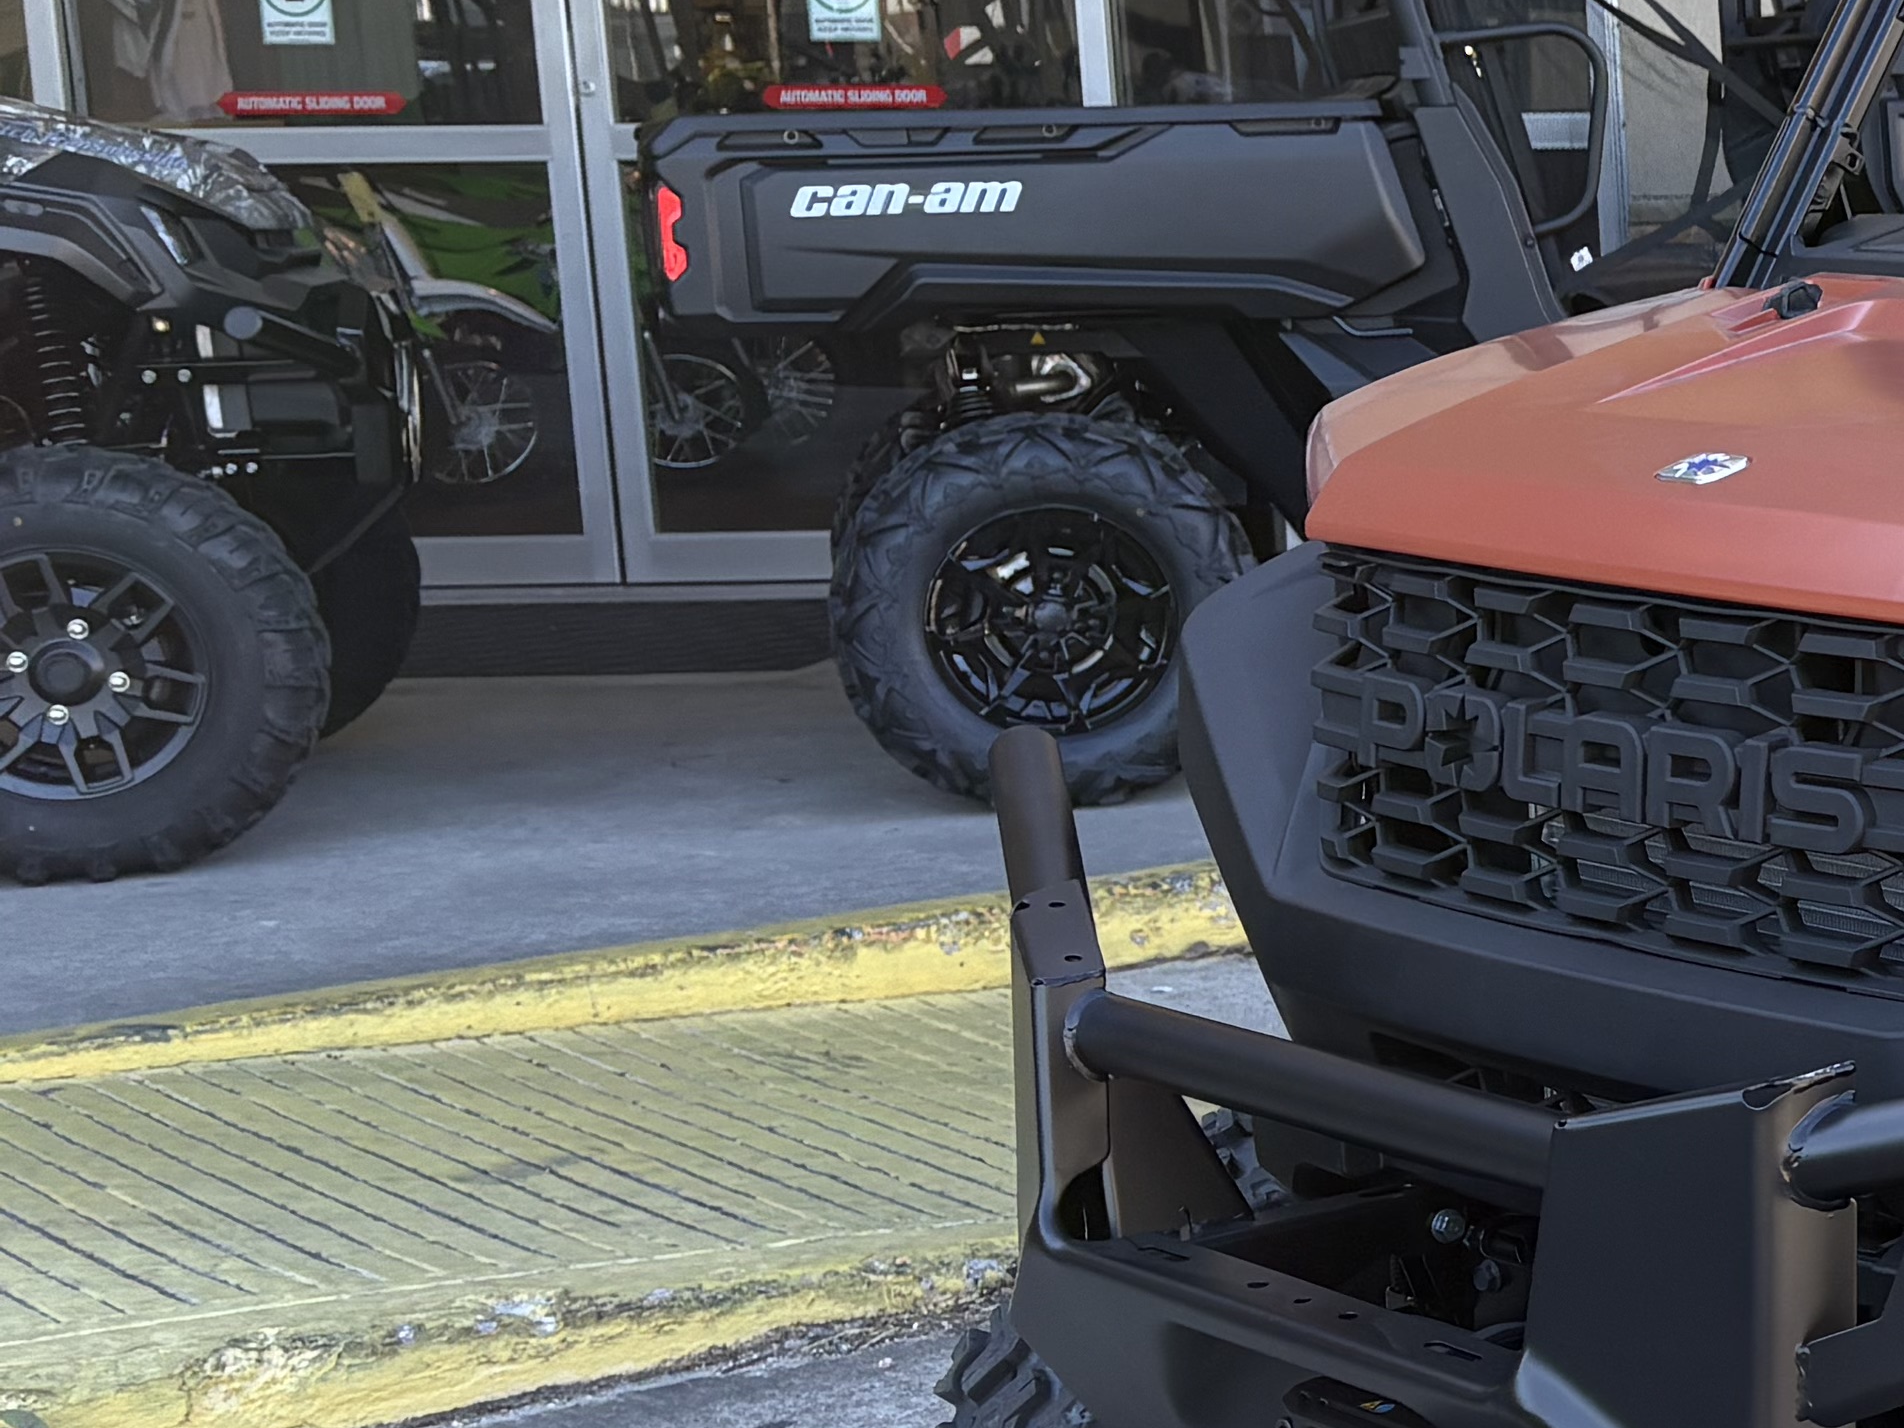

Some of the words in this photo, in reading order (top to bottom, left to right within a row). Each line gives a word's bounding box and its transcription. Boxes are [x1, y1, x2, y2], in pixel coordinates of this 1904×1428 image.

[236, 96, 303, 111] AUTOMATIC
[353, 95, 387, 110] DOOR
[779, 89, 846, 105] AUTOMATIC
[847, 89, 893, 105] SLIDING
[894, 89, 927, 104] DOOR
[789, 180, 1023, 218] can-am
[1356, 669, 1870, 856] POLARIS
